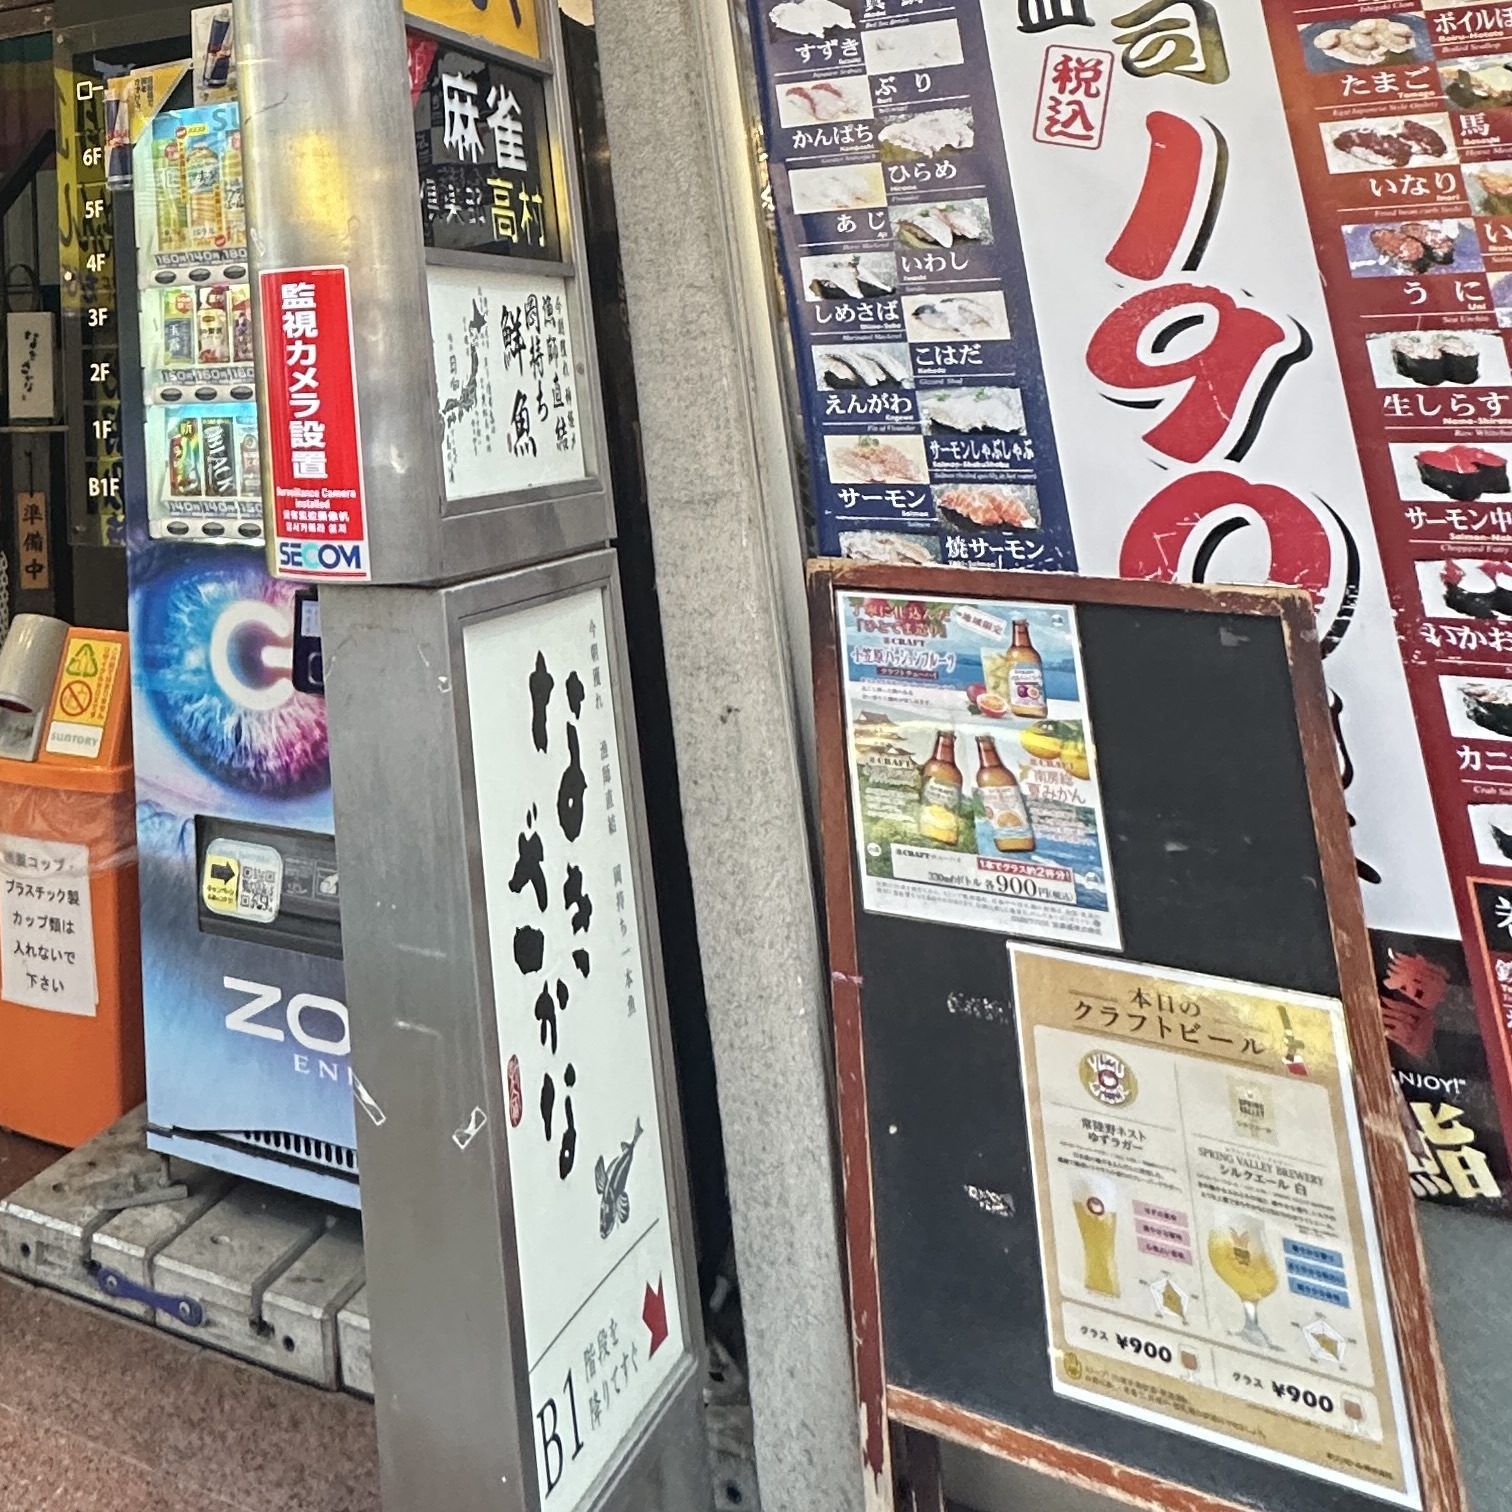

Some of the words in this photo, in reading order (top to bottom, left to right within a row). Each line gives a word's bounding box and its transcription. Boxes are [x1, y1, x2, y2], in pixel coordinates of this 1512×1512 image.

[795, 38, 860, 63] すずき
[875, 73, 931, 97] ぶり
[1341, 66, 1430, 97] たまご
[1044, 54, 1101, 144] 税込
[441, 71, 528, 172] 麻雀
[793, 123, 874, 149] かんぱち
[82, 148, 102, 166] 6F
[888, 160, 957, 183] ひらめ
[1370, 172, 1456, 197] いなり
[85, 201, 104, 219] 5F
[487, 176, 545, 247] 高村
[837, 211, 886, 232] あじ
[86, 254, 106, 272] 4F
[901, 252, 969, 273] いわし
[1404, 280, 1485, 305] うに
[88, 308, 108, 326] 3F
[815, 300, 900, 324] しめさば
[915, 344, 983, 366] こはだ
[90, 363, 110, 381] 2F
[281, 282, 328, 479] 監視カメラ設置
[501, 304, 538, 458] 鮮魚
[825, 393, 912, 416] えんがわ
[1383, 392, 1510, 417] 生しらす
[92, 420, 112, 439] 1F
[88, 478, 120, 497] B1F
[838, 488, 926, 508] サーモン
[22, 504, 43, 581] 準備中
[945, 536, 1044, 560] 焼サーモン
[280, 541, 361, 570] SECOM
[6, 879, 81, 906] プラスチック製
[13, 910, 75, 935] カップ類は
[14, 940, 76, 965] 入れないで
[26, 973, 65, 993] 下さい
[1129, 986, 1202, 1018] 本日の
[1073, 998, 1265, 1057] クラフトビール
[1198, 1146, 1234, 1166] SPRING
[1235, 1154, 1274, 1175] VALLEY
[1275, 1164, 1324, 1187] BREWERY
[583, 1317, 620, 1385] 階段を
[1079, 1325, 1109, 1342] グラス
[1116, 1333, 1172, 1364] ¥900
[1231, 1370, 1264, 1389] グラス
[1271, 1380, 1334, 1413] ¥900
[536, 1366, 584, 1500] B1
